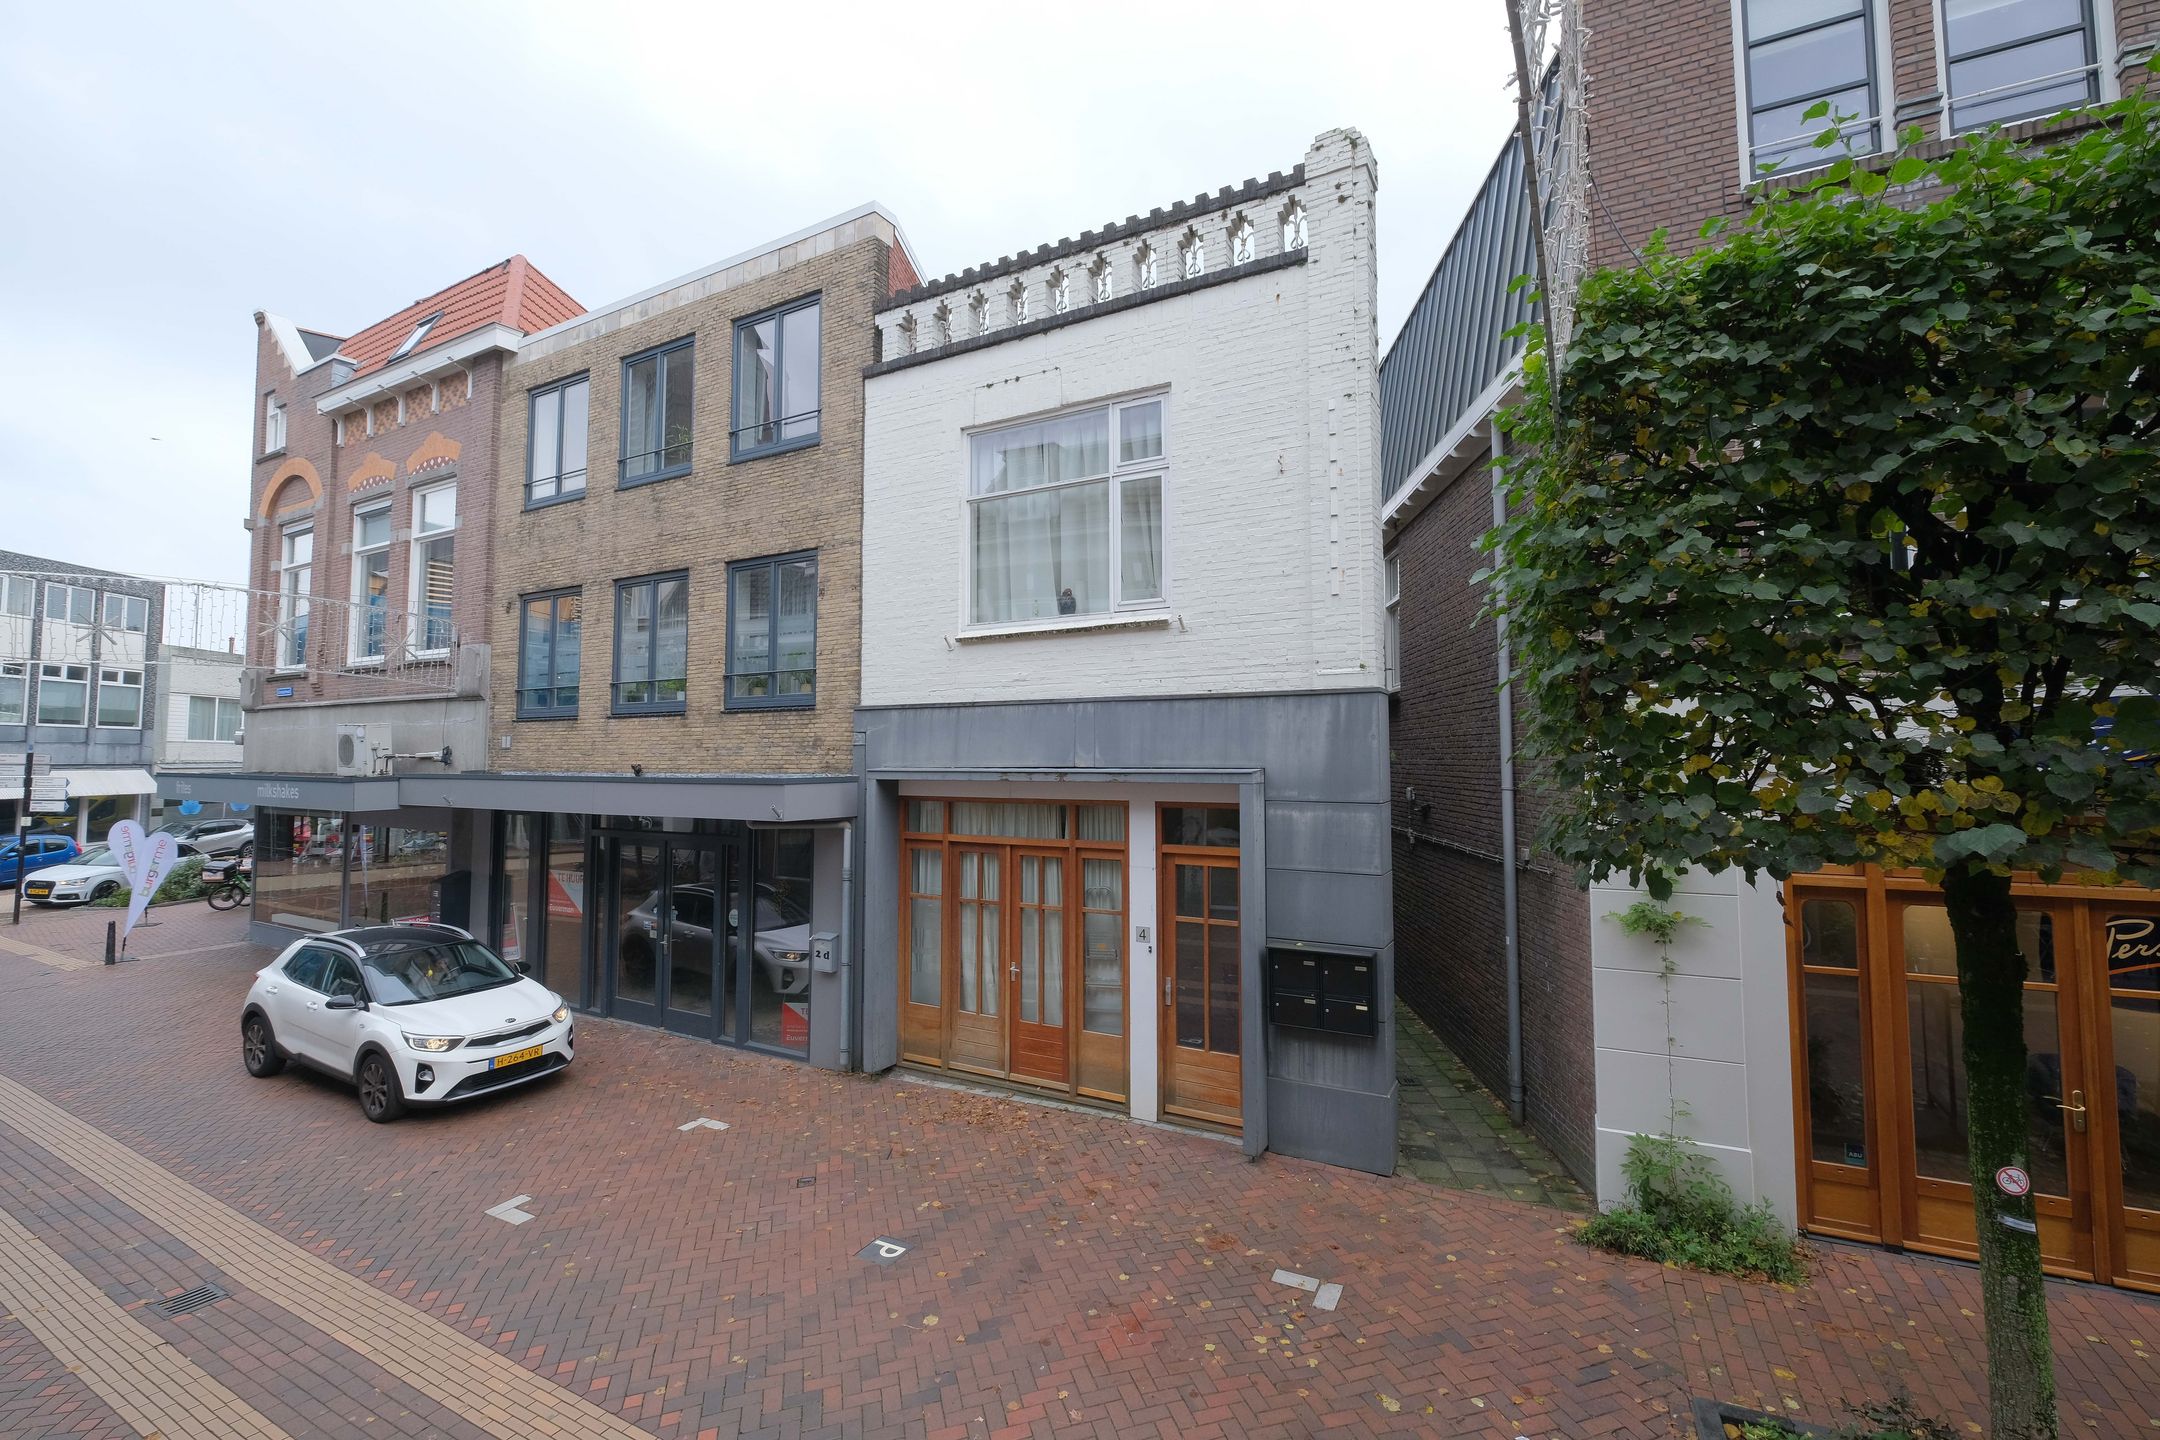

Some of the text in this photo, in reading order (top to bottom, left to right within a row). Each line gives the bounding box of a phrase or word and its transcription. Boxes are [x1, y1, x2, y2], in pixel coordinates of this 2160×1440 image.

[257, 783, 300, 799] milkshakes
[139, 839, 168, 897] burgerme
[1139, 929, 1146, 940] 4
[815, 950, 830, 960] 2 d
[497, 1047, 540, 1066] H-264-VR
[874, 1239, 906, 1258] P
